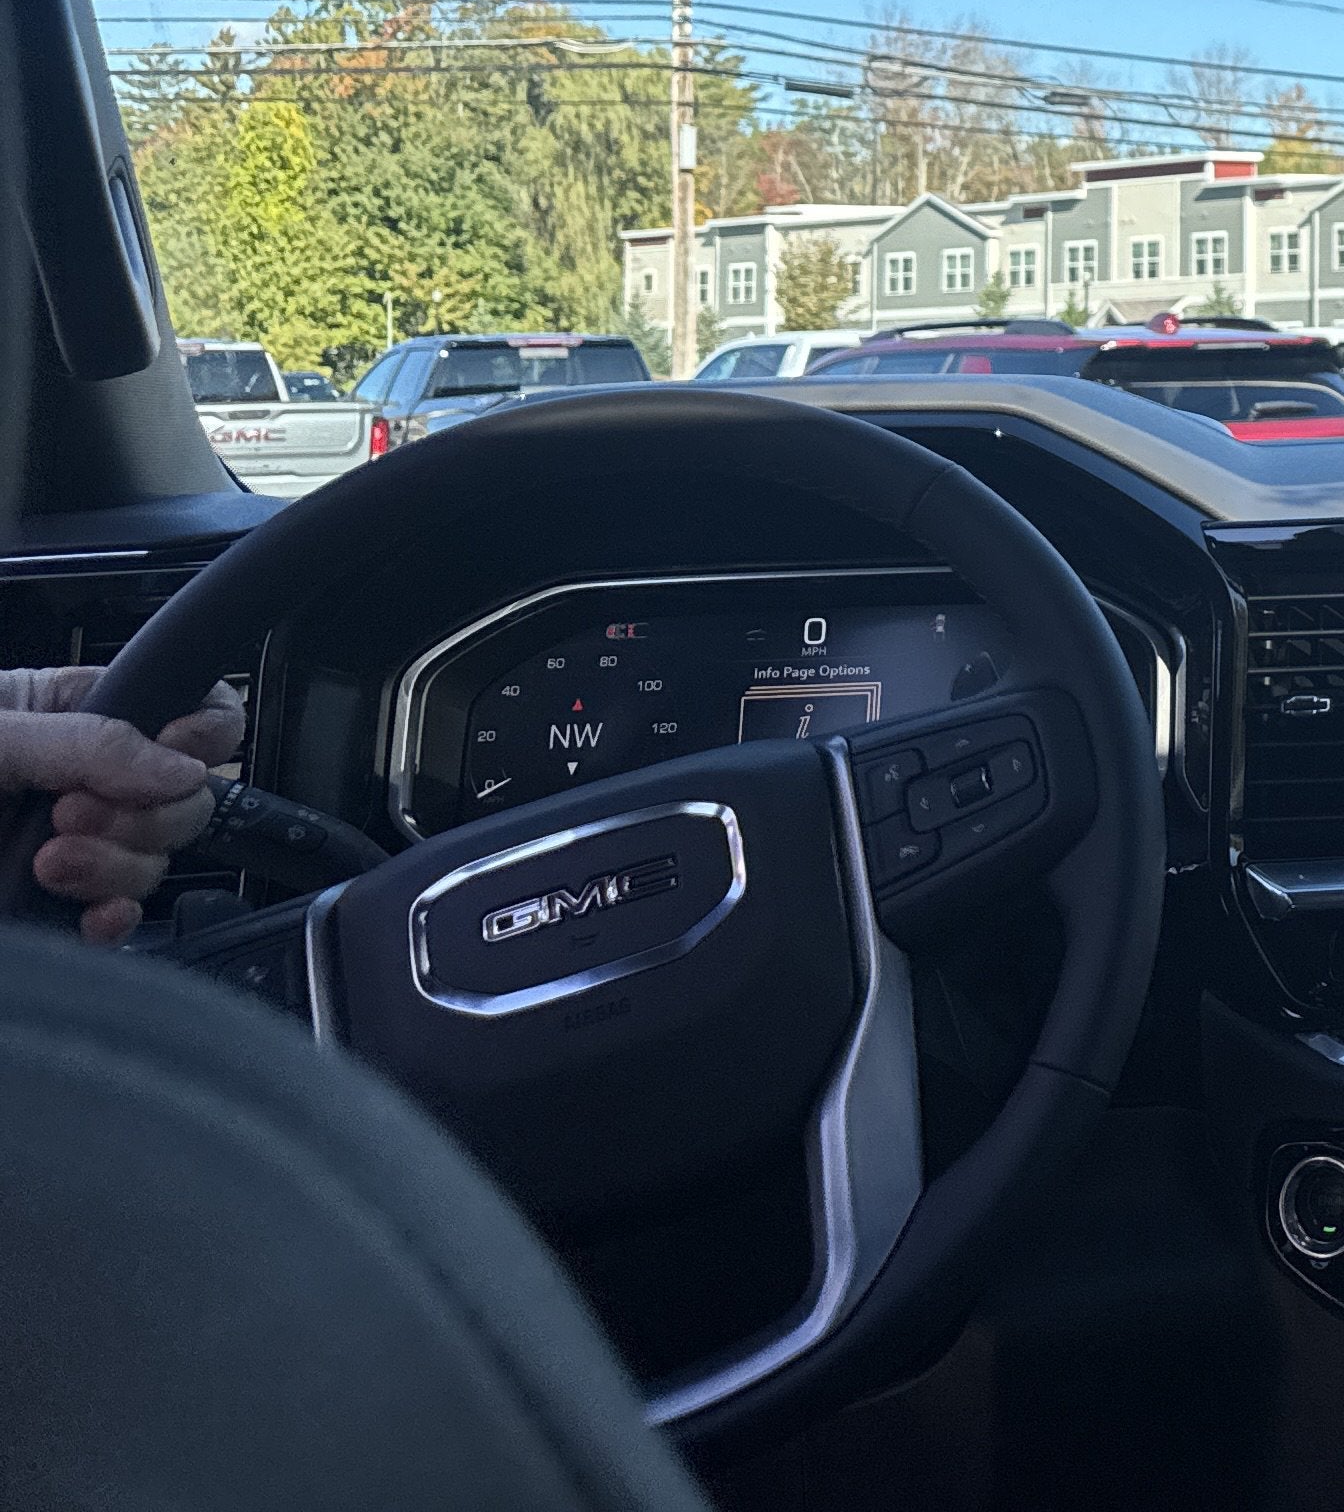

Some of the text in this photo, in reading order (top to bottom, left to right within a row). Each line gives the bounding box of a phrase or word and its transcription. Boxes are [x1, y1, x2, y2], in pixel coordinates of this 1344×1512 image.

[803, 617, 827, 645] 0
[801, 646, 827, 656] MPH
[546, 656, 618, 669] 60 80
[754, 664, 871, 680] Info Page Options
[501, 680, 663, 696] 40 100
[477, 722, 678, 750] 20 NW 120
[482, 853, 679, 944] GMC
